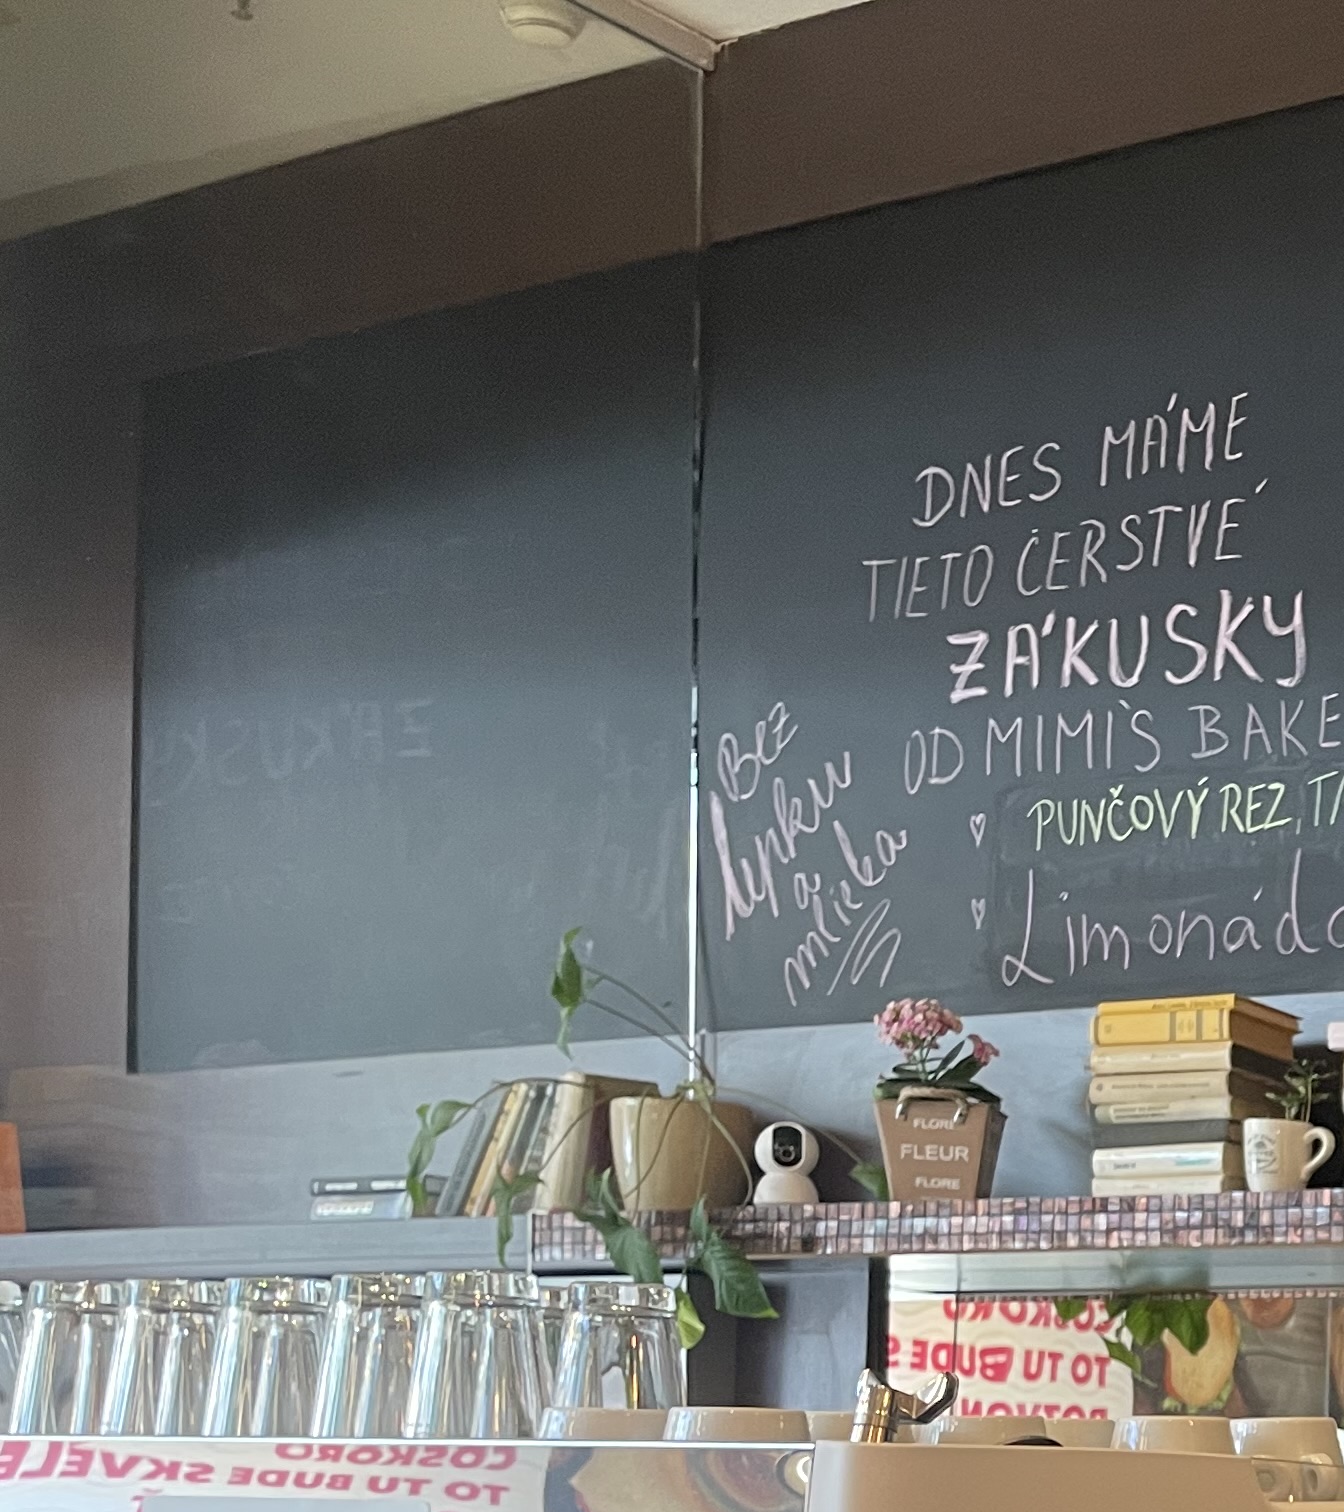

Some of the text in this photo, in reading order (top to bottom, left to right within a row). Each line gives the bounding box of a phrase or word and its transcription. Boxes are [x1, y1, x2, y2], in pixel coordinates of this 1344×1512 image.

[911, 392, 1249, 528] DNES MÁME
[861, 544, 995, 623] TIETO
[945, 588, 1311, 703] ZÁKUSKY
[903, 725, 965, 796] OD
[1026, 776, 1210, 852] PUNČOVÝ
[900, 1142, 969, 1163] FLEUR
[914, 1175, 961, 1190] FLORE
